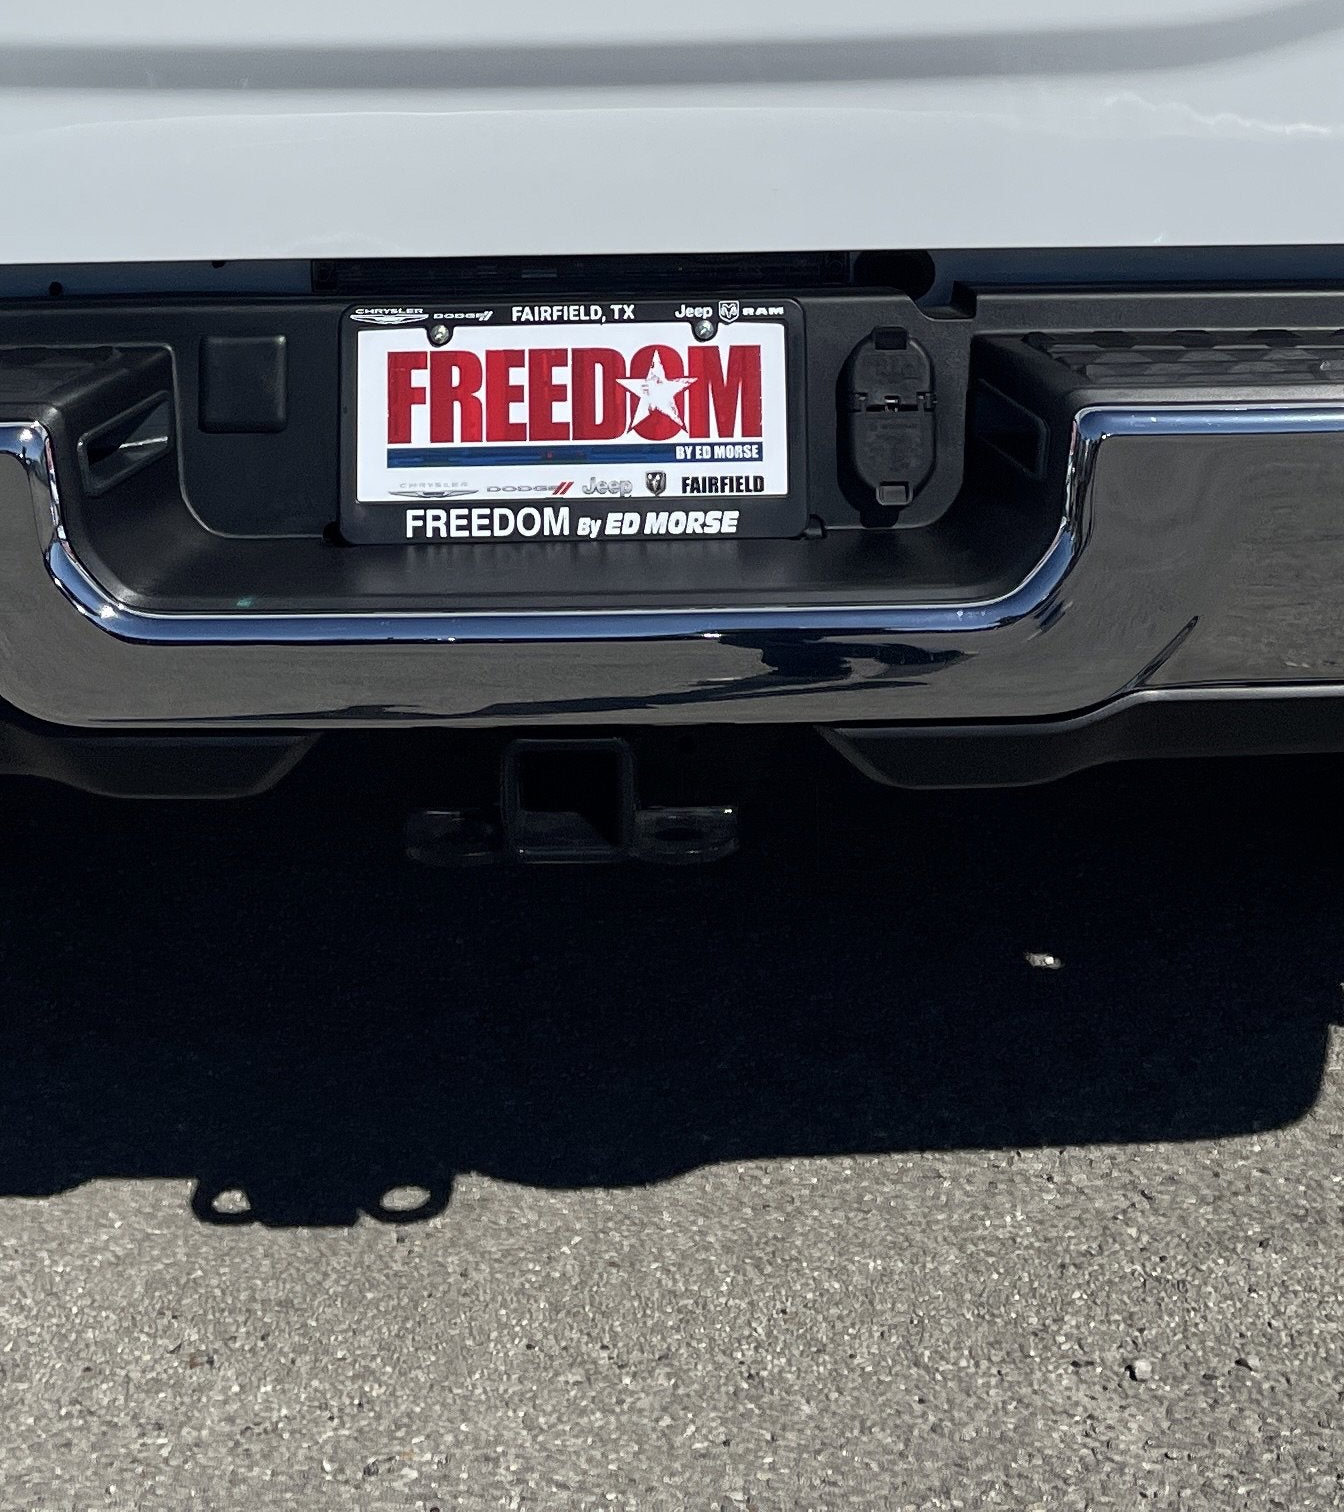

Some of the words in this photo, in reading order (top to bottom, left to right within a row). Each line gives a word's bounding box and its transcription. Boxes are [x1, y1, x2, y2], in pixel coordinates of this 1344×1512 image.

[511, 304, 607, 323] FAIRFIELD,
[610, 304, 635, 320] TX
[674, 303, 713, 319] Jeep
[742, 306, 784, 316] RAM
[386, 343, 763, 445] FREEDOM
[675, 445, 692, 460] BY
[695, 445, 711, 460] ED
[713, 444, 759, 459] MORSE
[581, 476, 633, 497] Jeep
[681, 475, 765, 495] FAIRFIELD
[406, 506, 570, 538] FREEDOM
[576, 517, 602, 538] By
[605, 511, 640, 536] ED
[644, 510, 740, 535] MORSE
